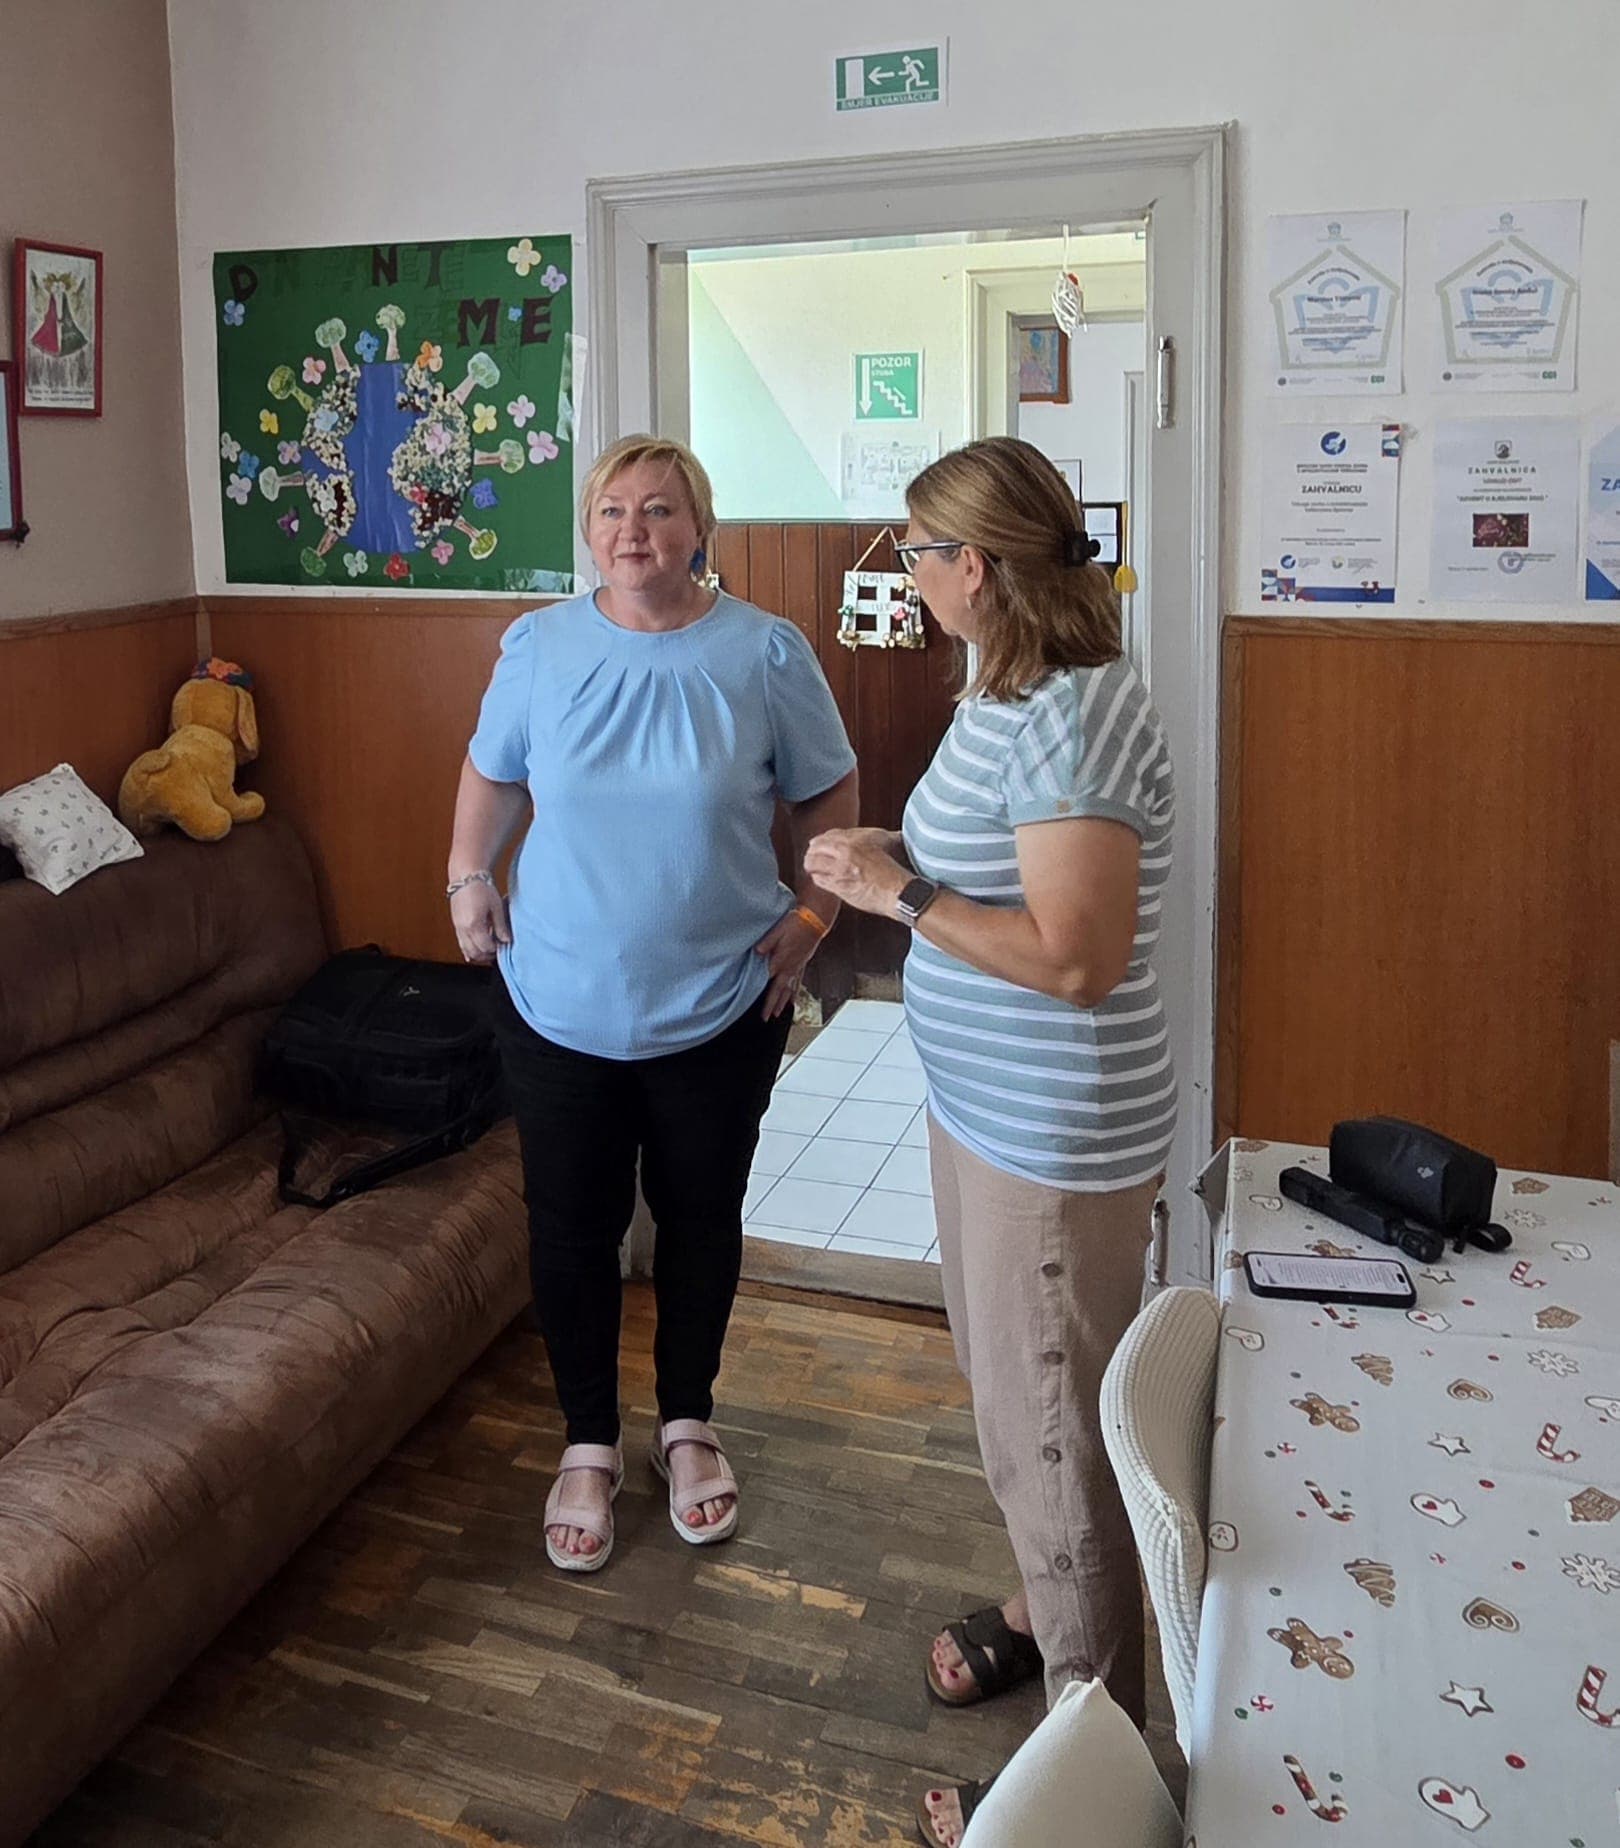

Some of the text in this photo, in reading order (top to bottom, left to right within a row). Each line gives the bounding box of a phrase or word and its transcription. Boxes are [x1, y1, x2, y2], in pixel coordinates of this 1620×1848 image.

[871, 356, 913, 369] POZOR
[1468, 465, 1537, 475] ZAHVALNICA
[1301, 485, 1363, 495] ZAHVALNICU
